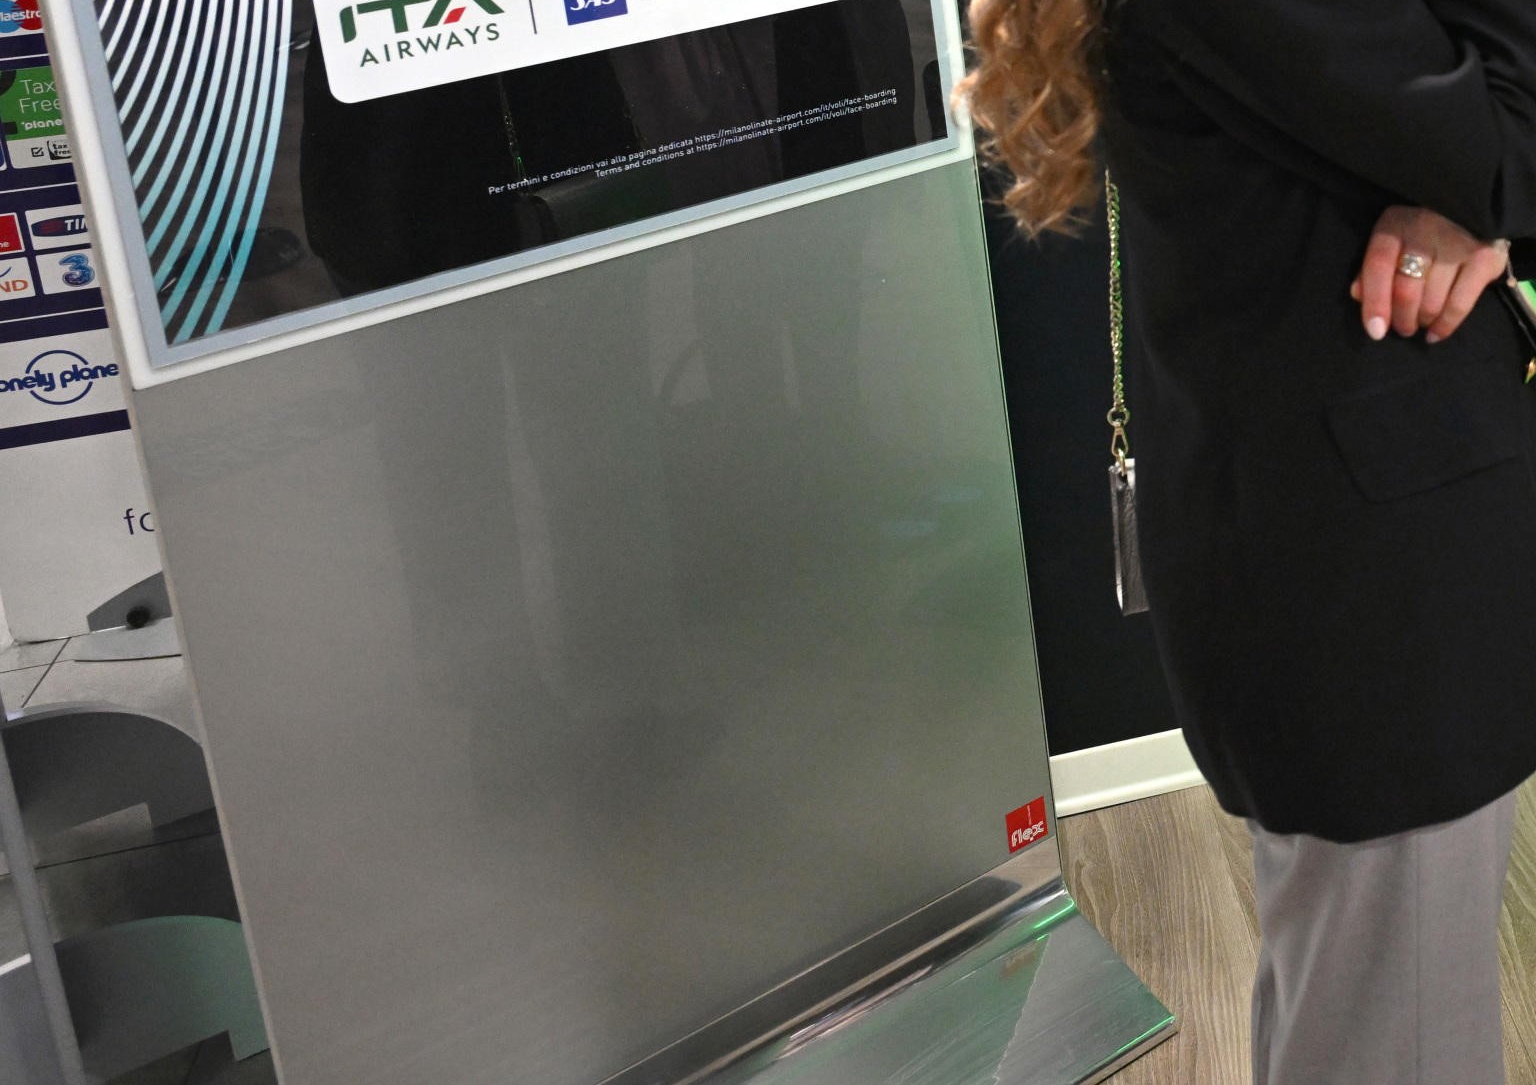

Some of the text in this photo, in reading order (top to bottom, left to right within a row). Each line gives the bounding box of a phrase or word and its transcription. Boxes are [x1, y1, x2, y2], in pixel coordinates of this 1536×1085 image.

[360, 23, 499, 67] AIRWAYS
[19, 79, 56, 95] Tax
[23, 118, 65, 131] plane
[488, 185, 505, 196] Per
[507, 177, 541, 191] termini
[542, 174, 549, 182] e
[550, 162, 595, 180] condizioni
[595, 158, 609, 168] vai
[610, 154, 627, 166] alla
[628, 147, 657, 163] pagina
[658, 137, 694, 153] dedicata
[594, 166, 623, 178] Terms
[624, 160, 640, 171] and
[642, 149, 685, 167] conditions
[686, 145, 695, 155] at
[59, 252, 95, 287] 3
[60, 363, 119, 389] plane
